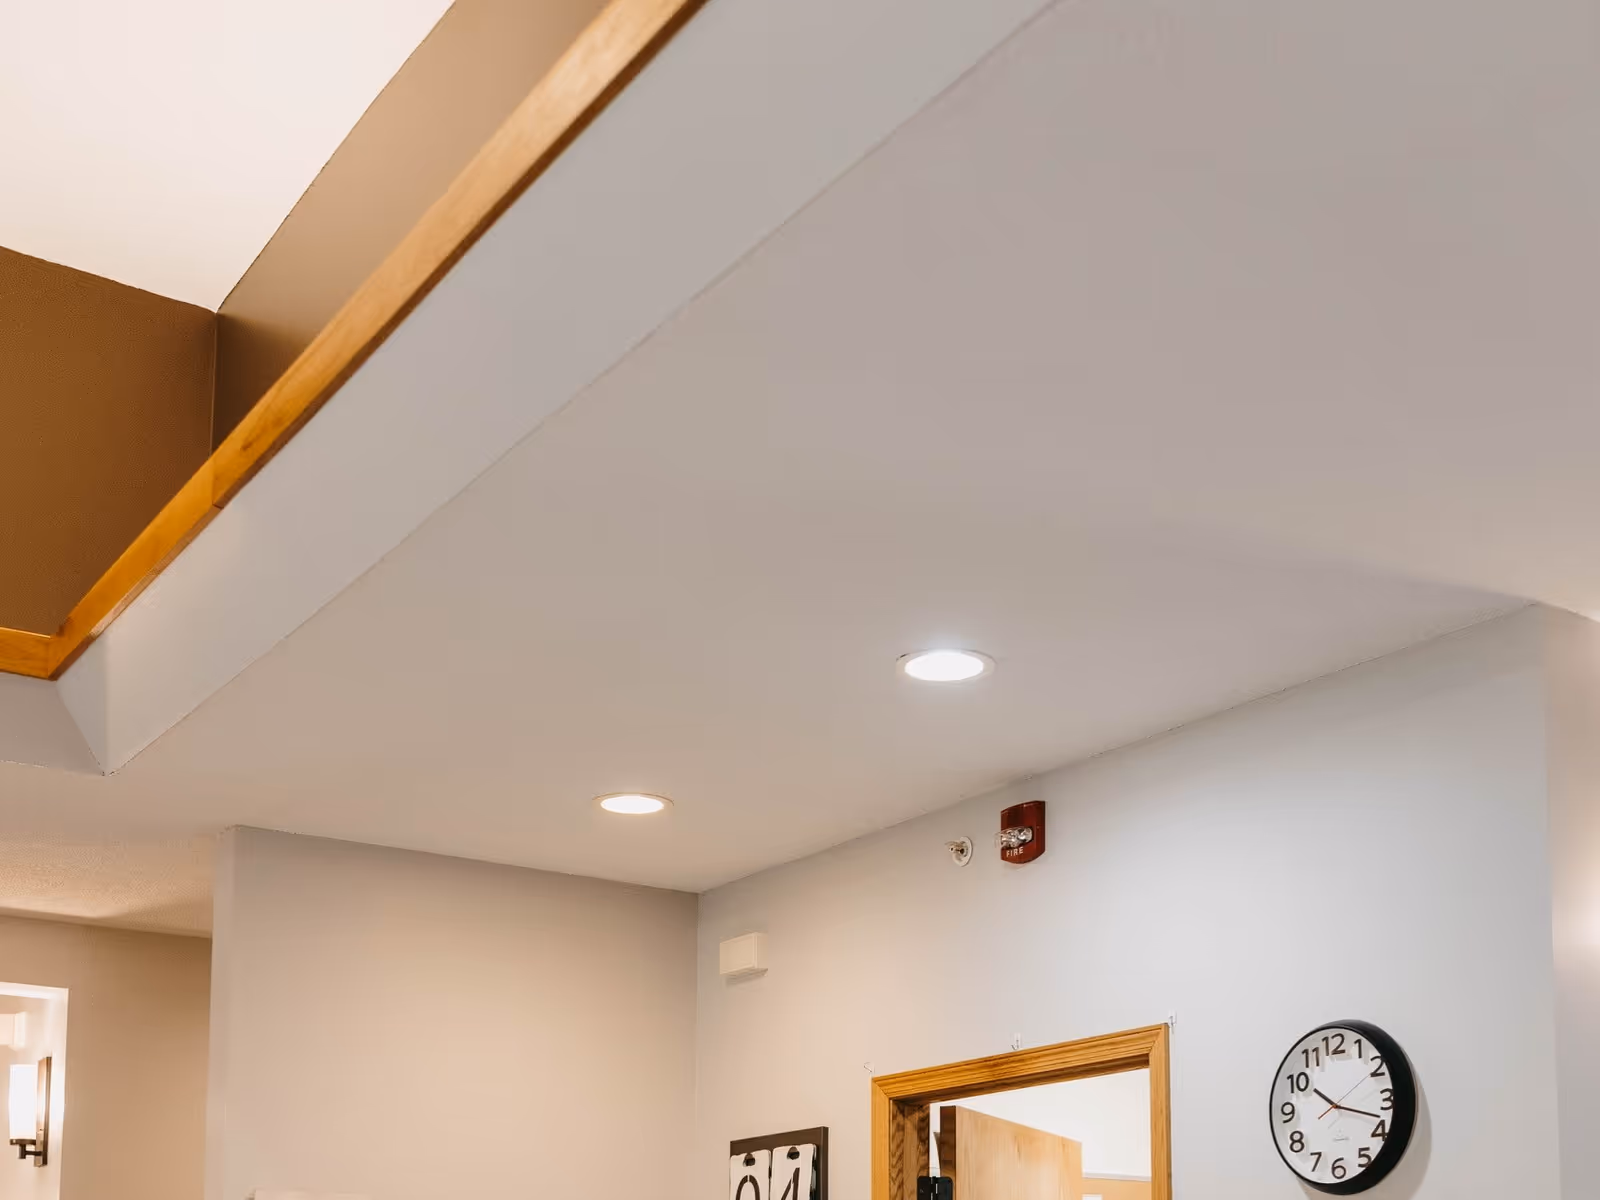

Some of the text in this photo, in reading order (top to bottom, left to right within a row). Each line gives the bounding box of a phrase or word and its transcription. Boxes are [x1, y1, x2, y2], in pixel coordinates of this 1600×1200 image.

[1006, 847, 1024, 857] FIRE
[1322, 1033, 1345, 1056] 12
[1354, 1039, 1362, 1058] 1
[1302, 1047, 1319, 1068] 11
[1370, 1056, 1385, 1077] 2
[1287, 1072, 1309, 1093] 10
[1380, 1088, 1394, 1110] 3
[1281, 1102, 1295, 1123] 9
[1371, 1120, 1387, 1141] 4
[1290, 1131, 1304, 1152] 8
[1310, 1152, 1322, 1172] 7
[1358, 1147, 1371, 1168] 5
[1331, 1158, 1346, 1179] 6
